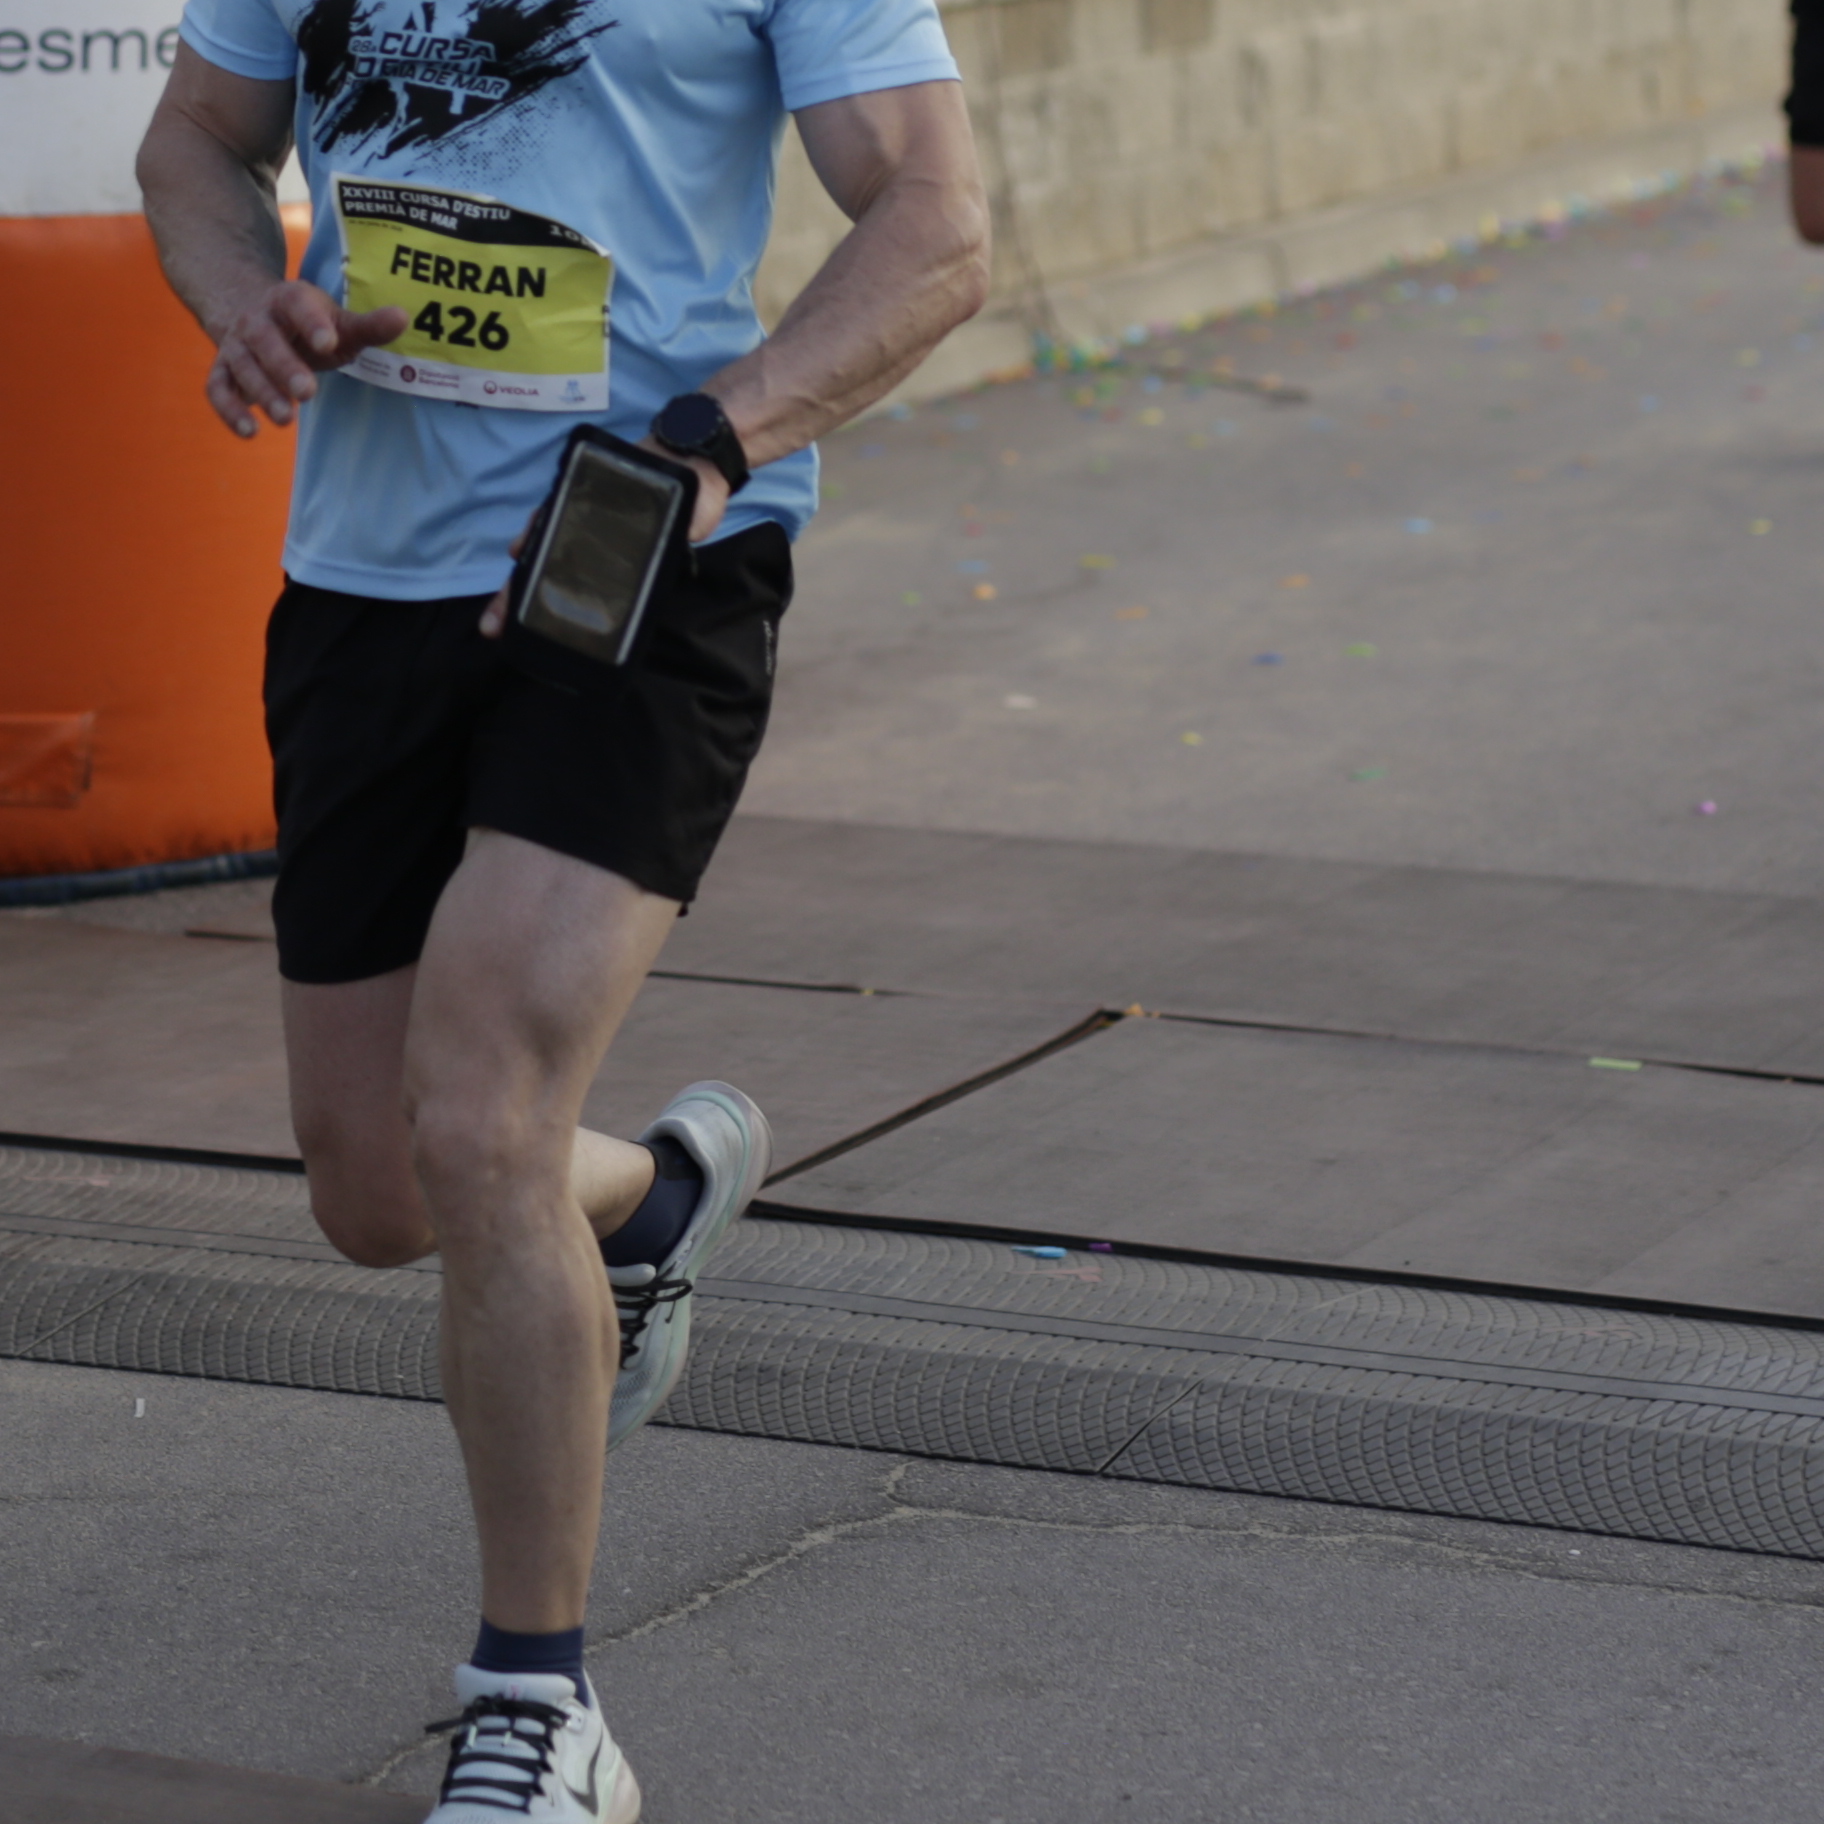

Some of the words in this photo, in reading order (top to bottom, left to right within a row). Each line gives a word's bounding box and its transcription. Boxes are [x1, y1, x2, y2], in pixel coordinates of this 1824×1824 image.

[379, 31, 494, 62] CURSA
[451, 73, 507, 97] MAR
[342, 185, 396, 202] XXVIII
[399, 190, 451, 210] CURSA
[453, 199, 511, 221] D'ESTIU
[345, 200, 406, 217] PREMIÀ
[409, 206, 428, 221] DE
[431, 212, 459, 231] MAR
[390, 244, 546, 298] FERRAN
[413, 300, 510, 351] 426
[498, 385, 540, 397] VEOLIA
